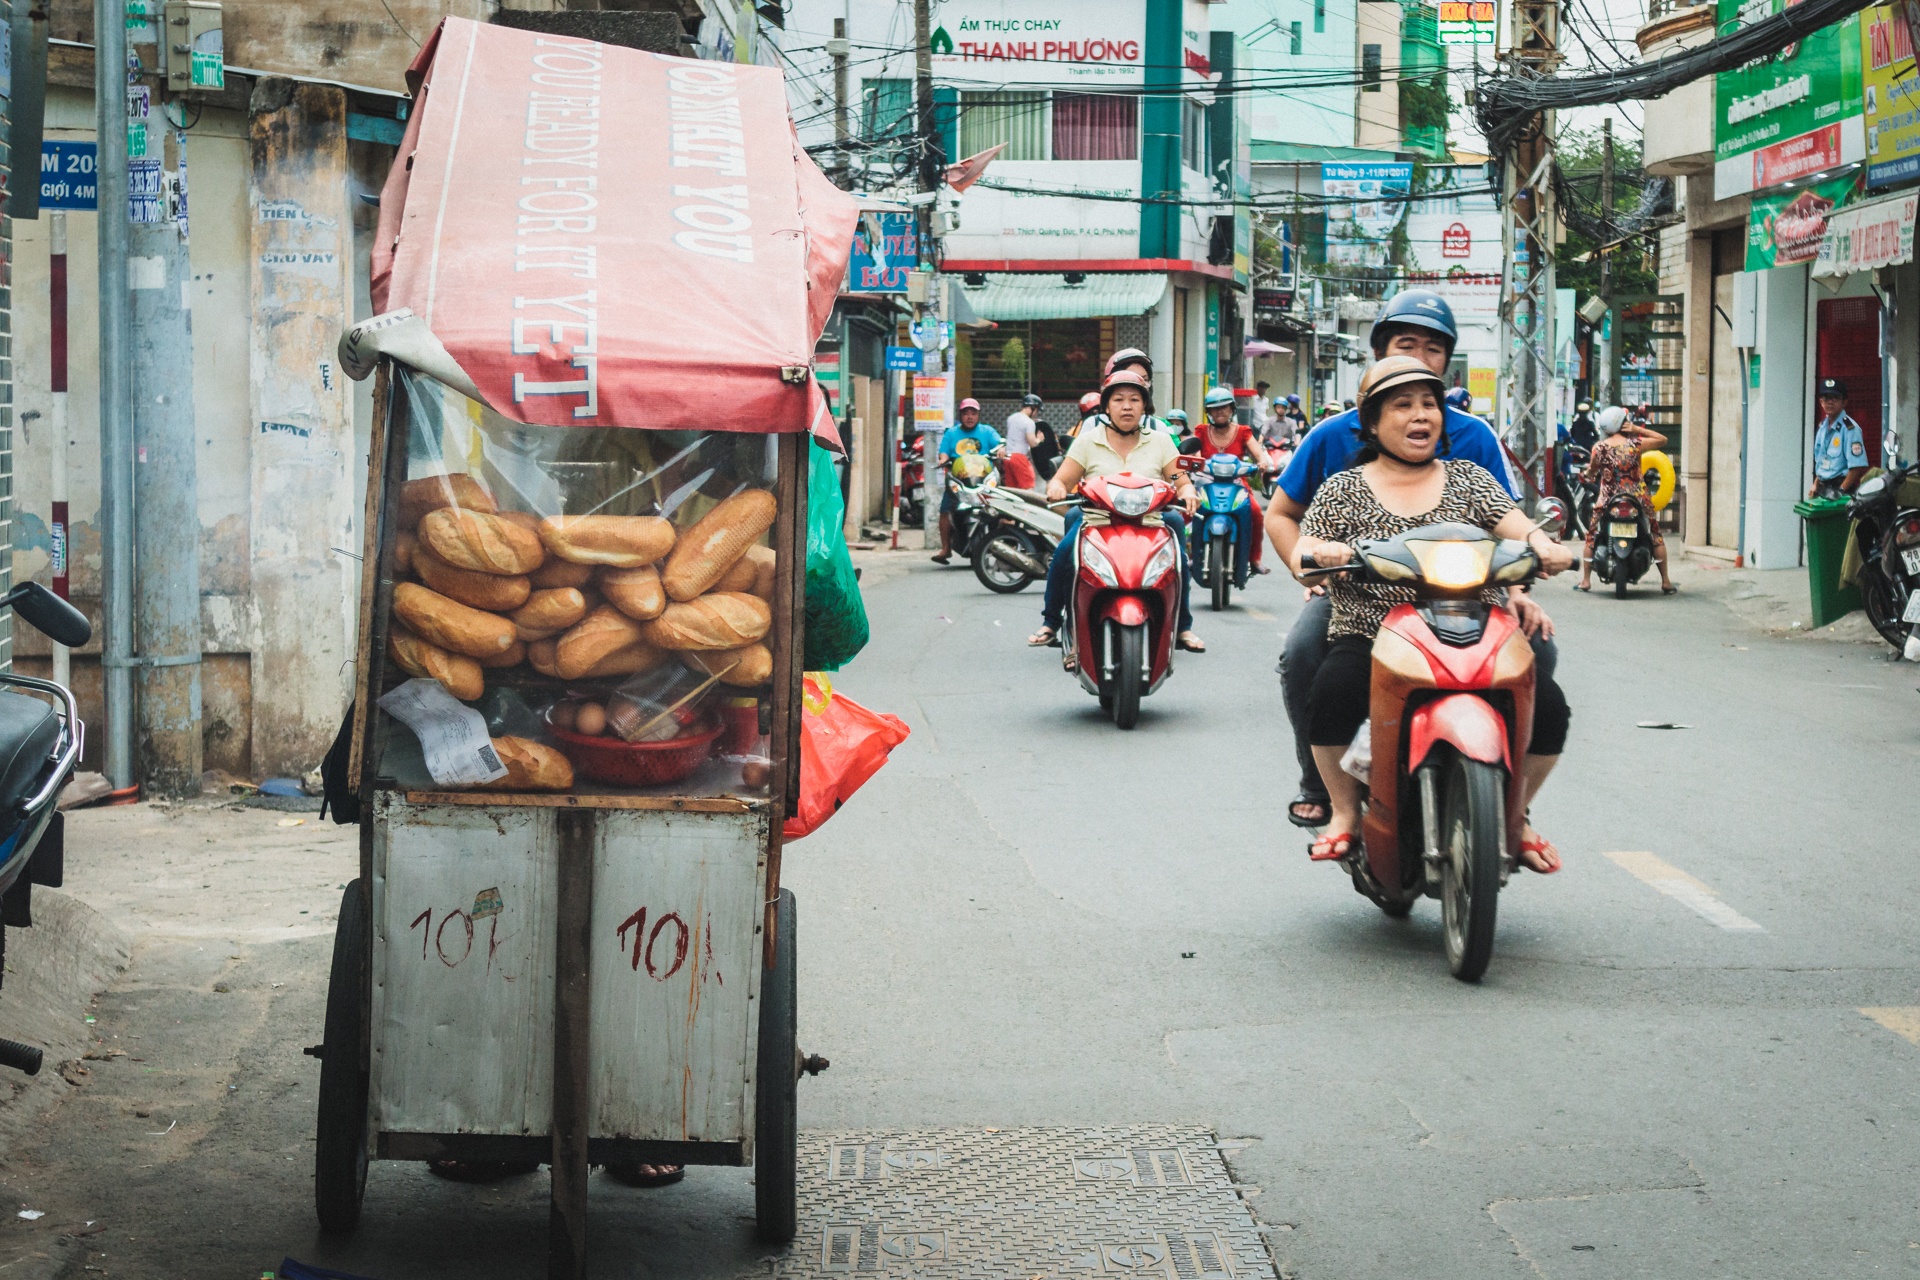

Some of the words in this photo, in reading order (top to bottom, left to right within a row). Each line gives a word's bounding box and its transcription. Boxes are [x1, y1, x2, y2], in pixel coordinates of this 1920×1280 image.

[985, 19, 1020, 34] THỰC
[1024, 20, 1061, 31] CHAY
[530, 38, 603, 92] YOU
[959, 41, 1037, 61] THANH
[1044, 38, 1138, 62] PHƯƠNG
[522, 91, 600, 169] READY
[66, 154, 98, 174] 20
[74, 185, 95, 199] 4M
[515, 176, 599, 236] FOR
[671, 183, 754, 264] YOU
[513, 244, 598, 279] IT
[511, 290, 599, 419] YET
